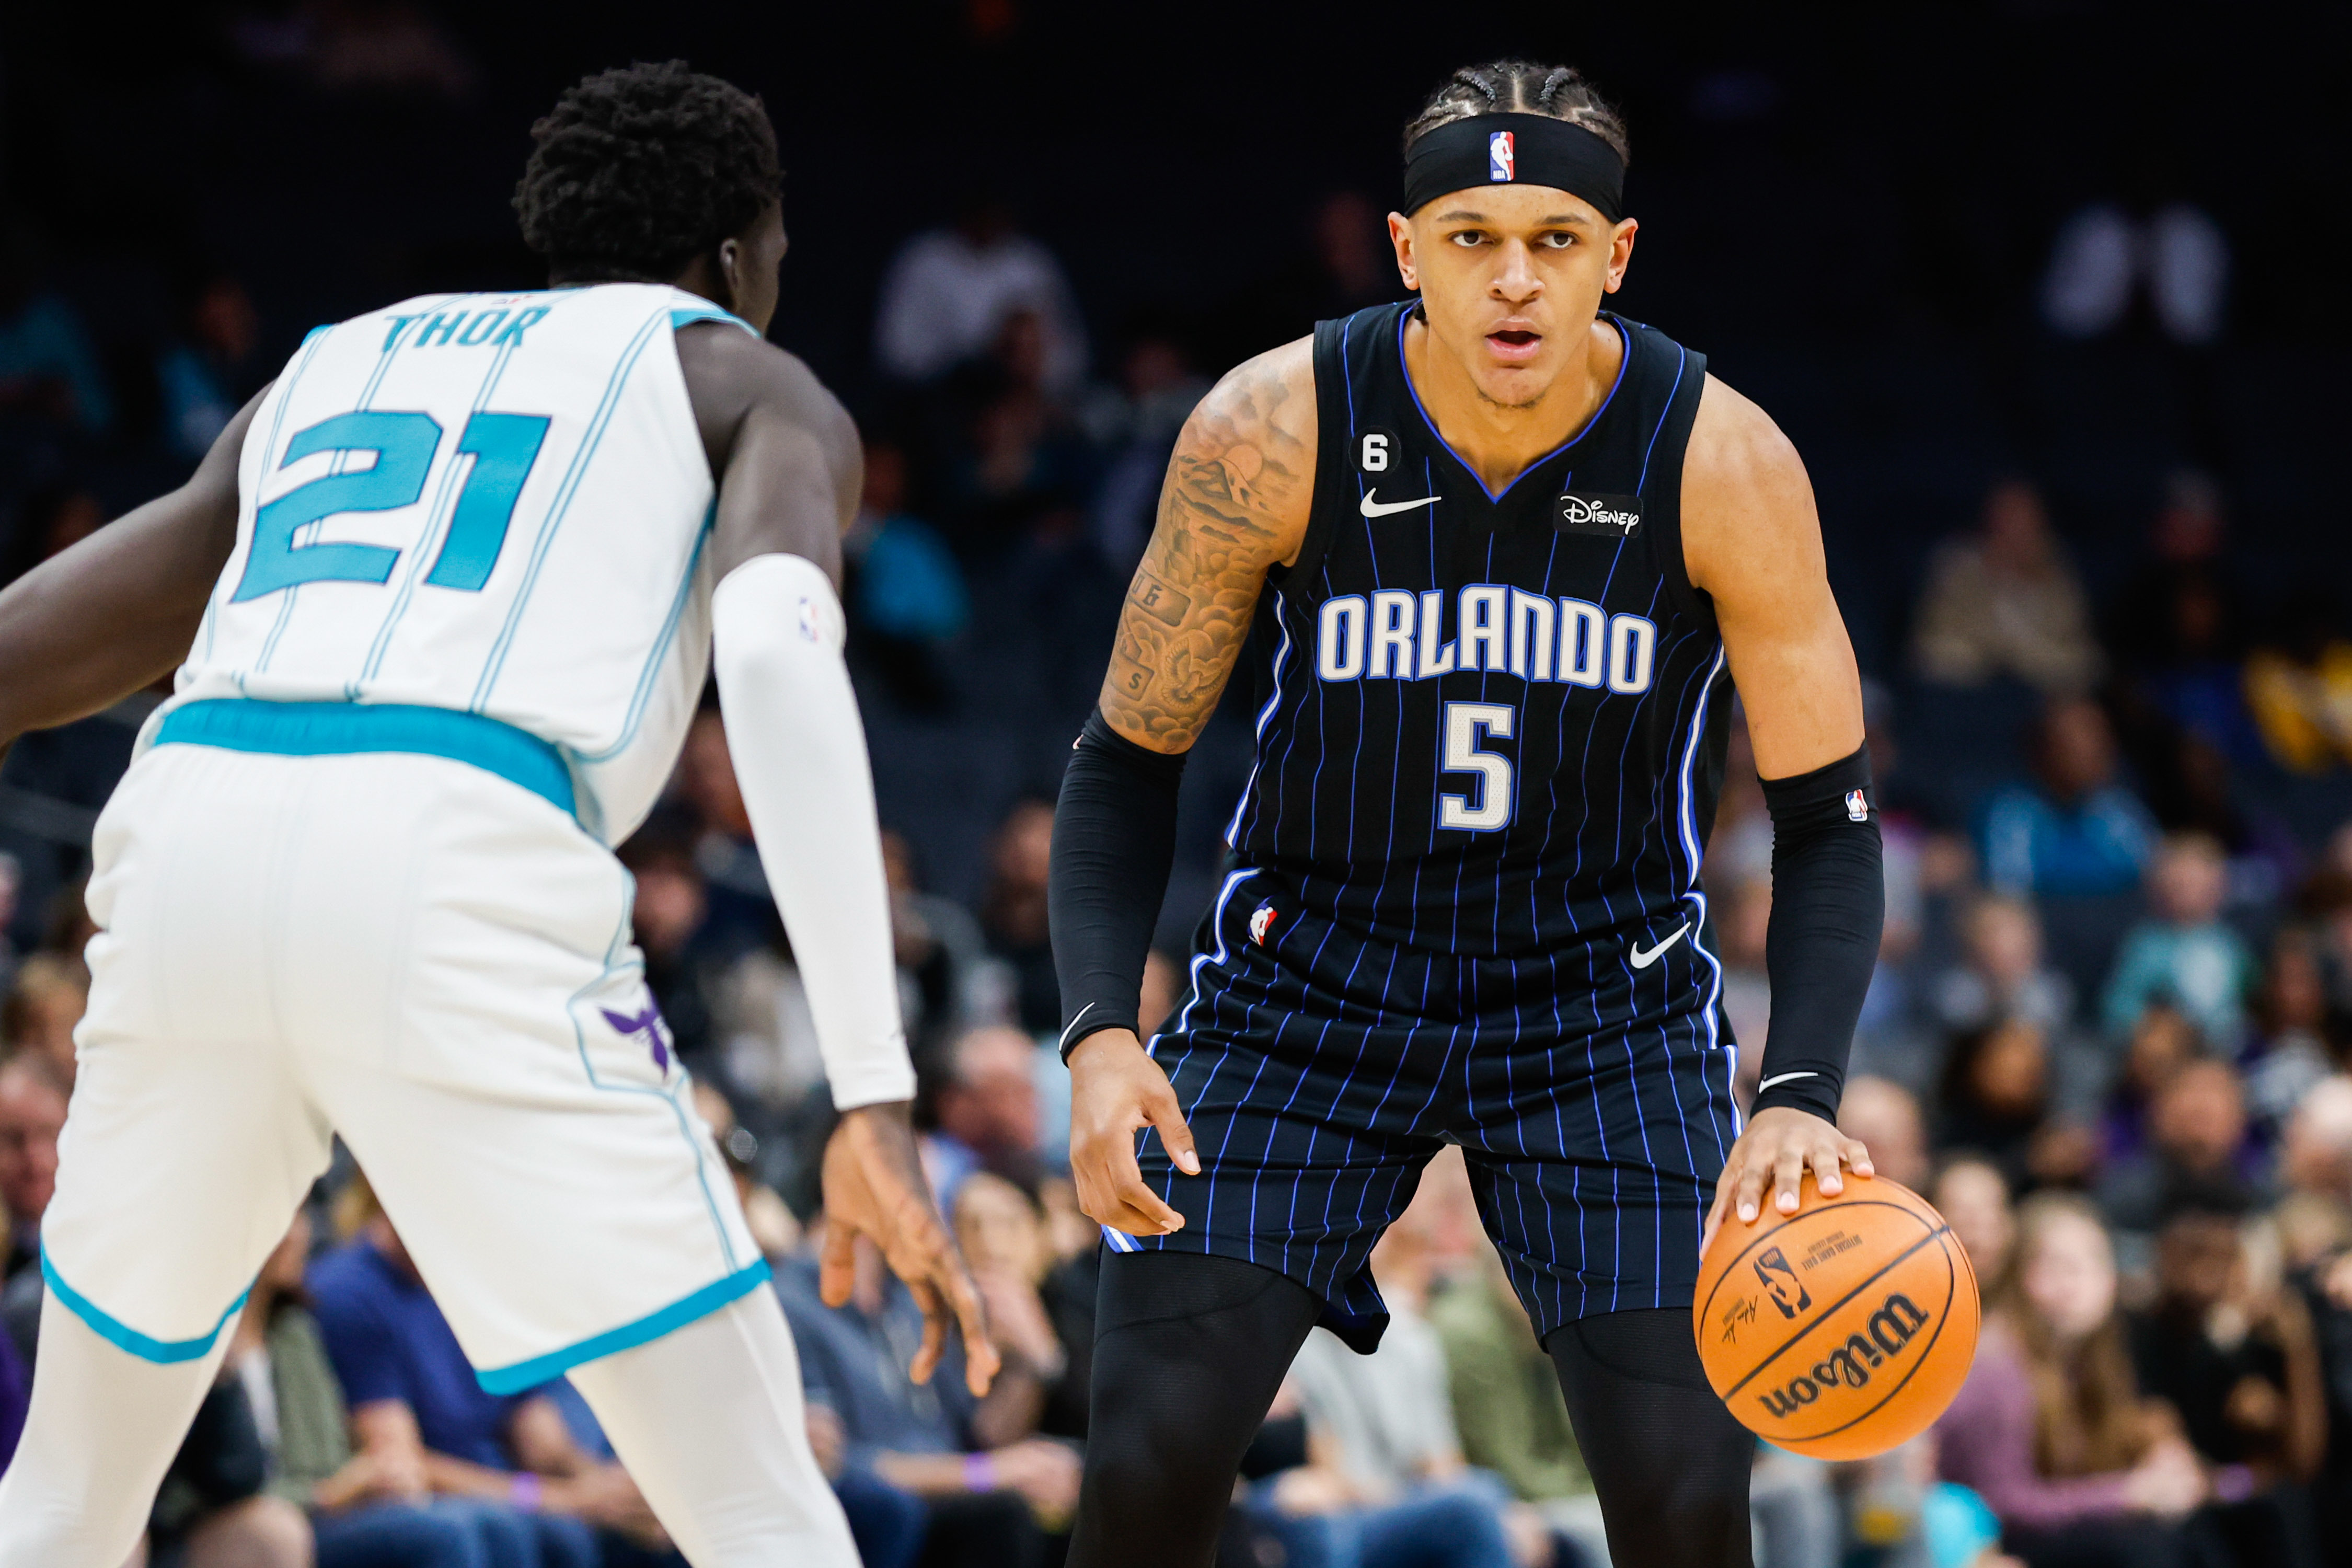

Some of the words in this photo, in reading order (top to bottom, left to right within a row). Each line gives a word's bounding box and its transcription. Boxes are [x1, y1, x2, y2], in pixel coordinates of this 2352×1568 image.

[1493, 170, 1506, 179] NBA
[381, 305, 553, 353] THOR
[227, 410, 553, 605] 21
[1362, 434, 1388, 471] 6
[1316, 583, 1657, 695] ORLANDO
[1437, 701, 1516, 833] 5
[1758, 1290, 1931, 1419] Wilson
